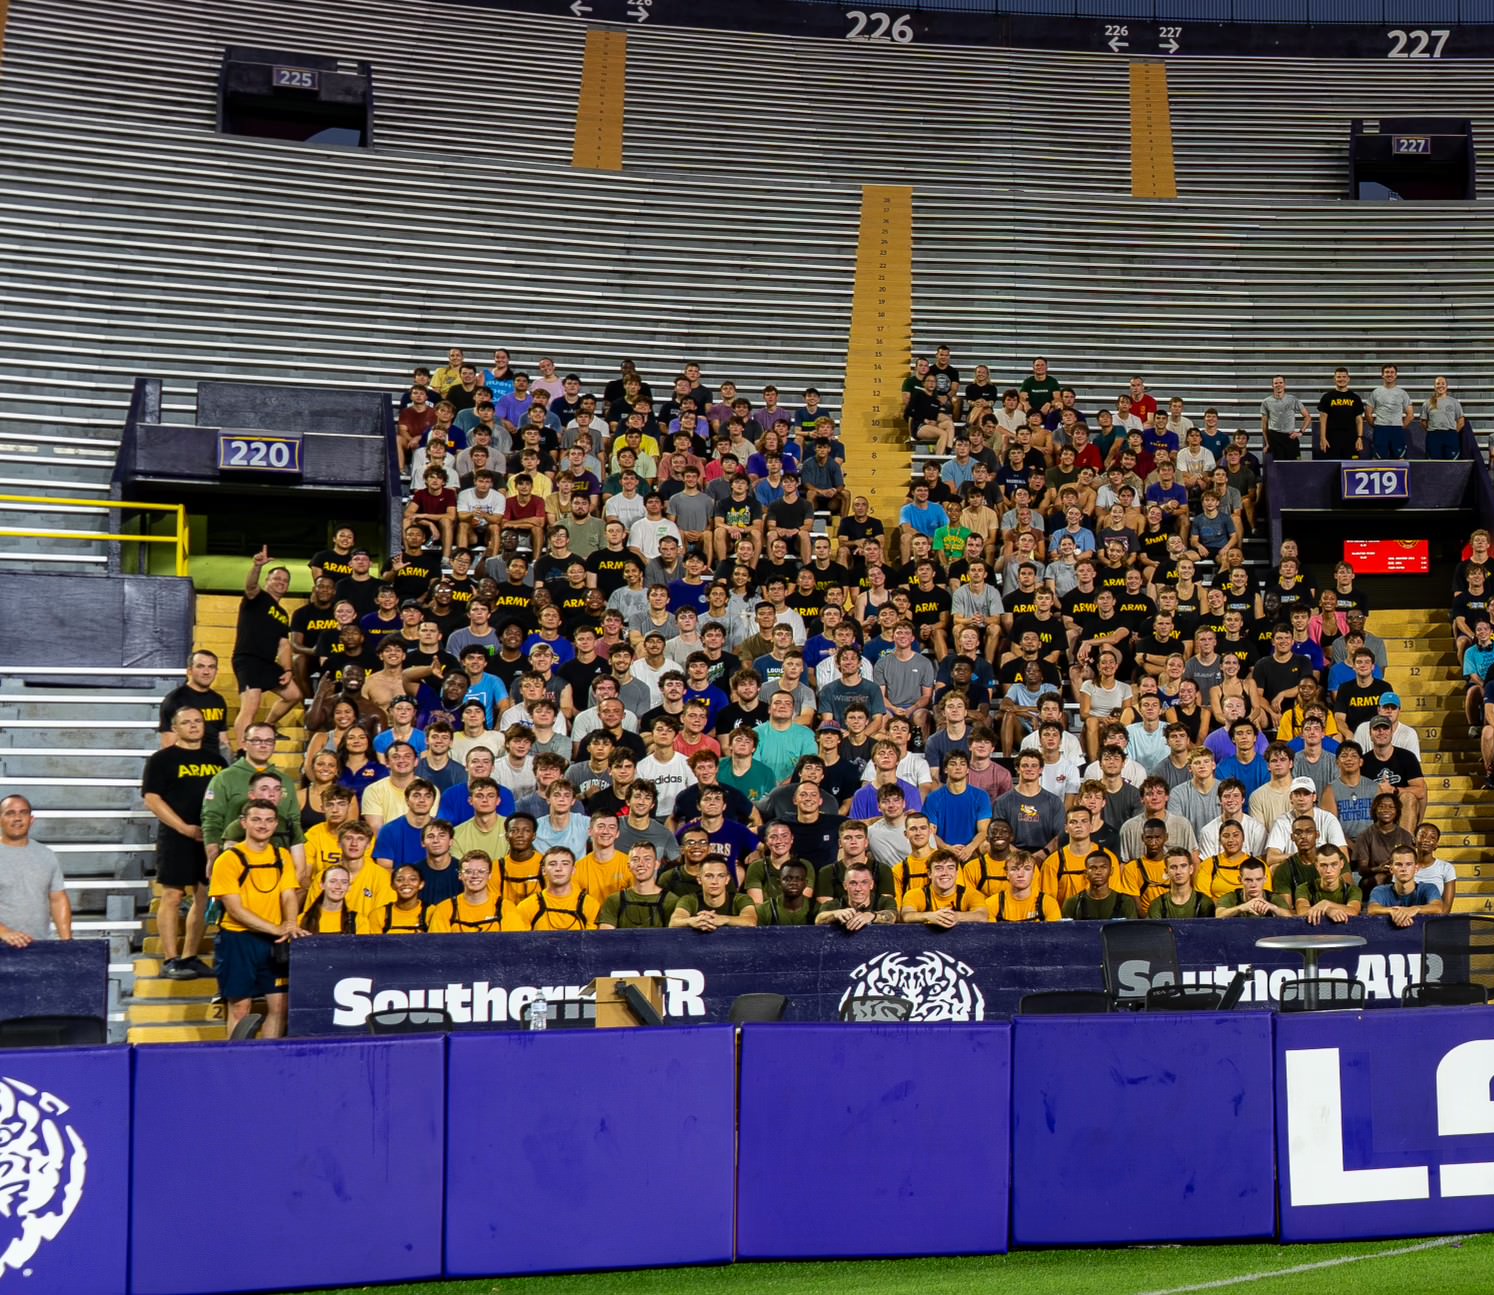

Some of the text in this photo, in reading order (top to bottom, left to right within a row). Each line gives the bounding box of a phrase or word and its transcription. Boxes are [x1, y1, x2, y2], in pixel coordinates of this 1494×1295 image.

[846, 10, 913, 43] 226
[1105, 25, 1128, 36] 226
[1160, 27, 1182, 37] 227
[1387, 30, 1450, 58] 227
[280, 70, 312, 87] 225
[1400, 139, 1425, 153] 227
[1330, 398, 1354, 408] ARMY
[230, 440, 290, 467] 220
[871, 452, 877, 460] 8
[571, 481, 590, 491] SU
[1355, 471, 1398, 495] 219
[869, 506, 875, 514] 5
[323, 562, 353, 574] ARMY
[398, 567, 429, 578] ARMY
[908, 575, 920, 585] AR
[1166, 571, 1179, 579] AR
[859, 577, 871, 588] AR
[1103, 579, 1126, 587] ARM
[1222, 583, 1233, 591] AR
[452, 591, 473, 602] RMY
[496, 597, 529, 608] ARMY
[563, 599, 586, 608] ARM
[1120, 603, 1147, 612] ARMY
[1210, 625, 1227, 633] RM
[1040, 632, 1053, 642] MY
[1169, 630, 1181, 640] MY
[1258, 632, 1272, 640] AR
[331, 643, 345, 653] AR
[1404, 640, 1414, 648] 13
[1233, 651, 1248, 661] MY
[335, 669, 372, 682] AY
[1410, 667, 1421, 676] 12
[832, 694, 869, 703] Wrangler
[1350, 696, 1380, 707] ARMY
[1416, 697, 1427, 706] 11
[203, 708, 224, 721] RMY
[1425, 729, 1437, 738] 10
[1435, 754, 1442, 762] 9
[1442, 779, 1450, 789] 8
[1453, 807, 1460, 816] 7
[1463, 835, 1470, 845] 6
[710, 843, 731, 856] ERS
[320, 849, 342, 865] LS
[1473, 865, 1482, 877] 5
[1484, 898, 1493, 911] 4
[1356, 953, 1443, 999] AIR
[212, 1003, 223, 1019] 2
